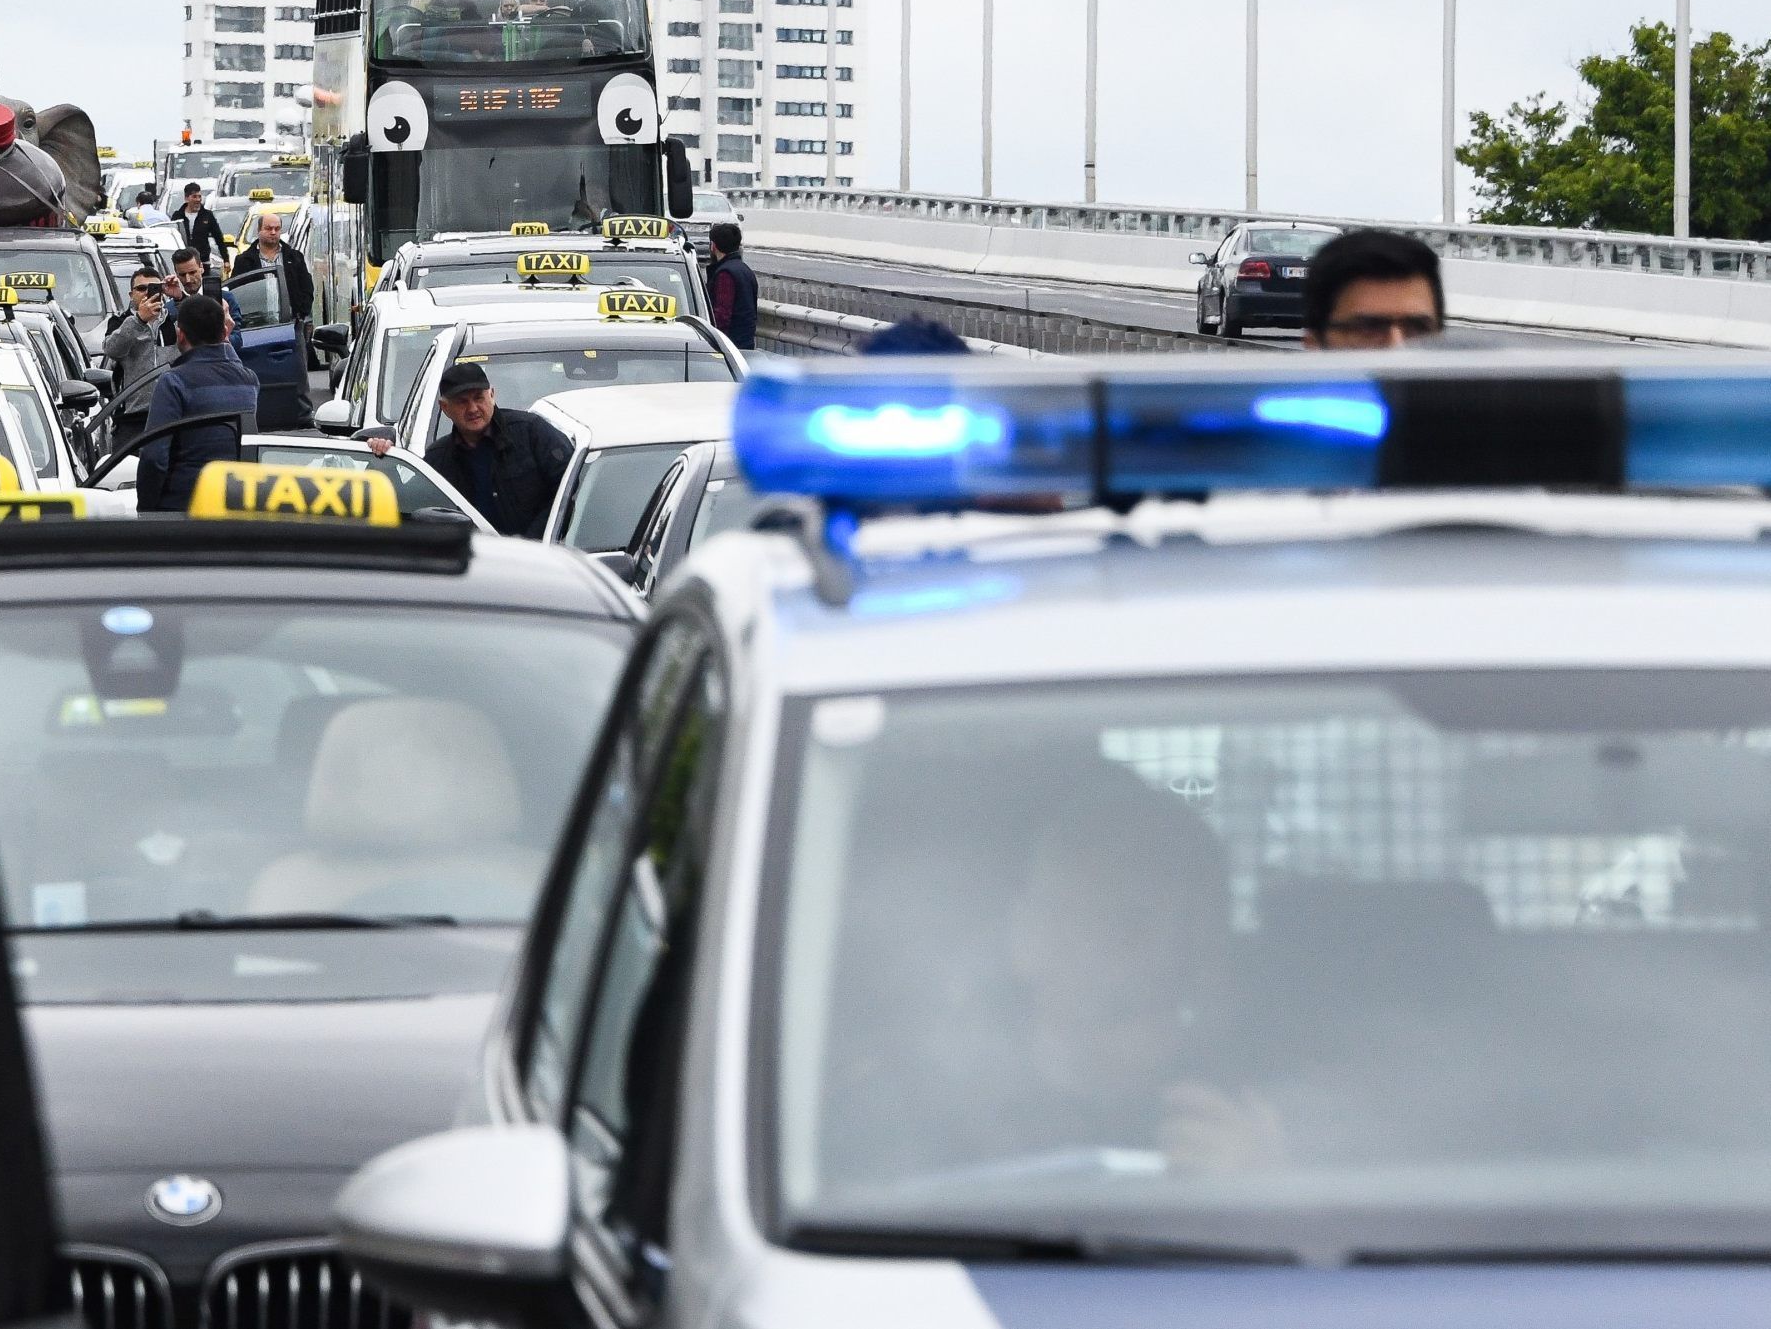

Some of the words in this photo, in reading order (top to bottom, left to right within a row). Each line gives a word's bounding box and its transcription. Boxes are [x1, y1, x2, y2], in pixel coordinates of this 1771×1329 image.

[516, 225, 545, 236] TAXI
[611, 219, 658, 236] TAXI
[527, 255, 578, 270] TAXI
[8, 273, 45, 285] TAXI
[610, 295, 665, 313] TAXI
[231, 473, 365, 519] TAXI
